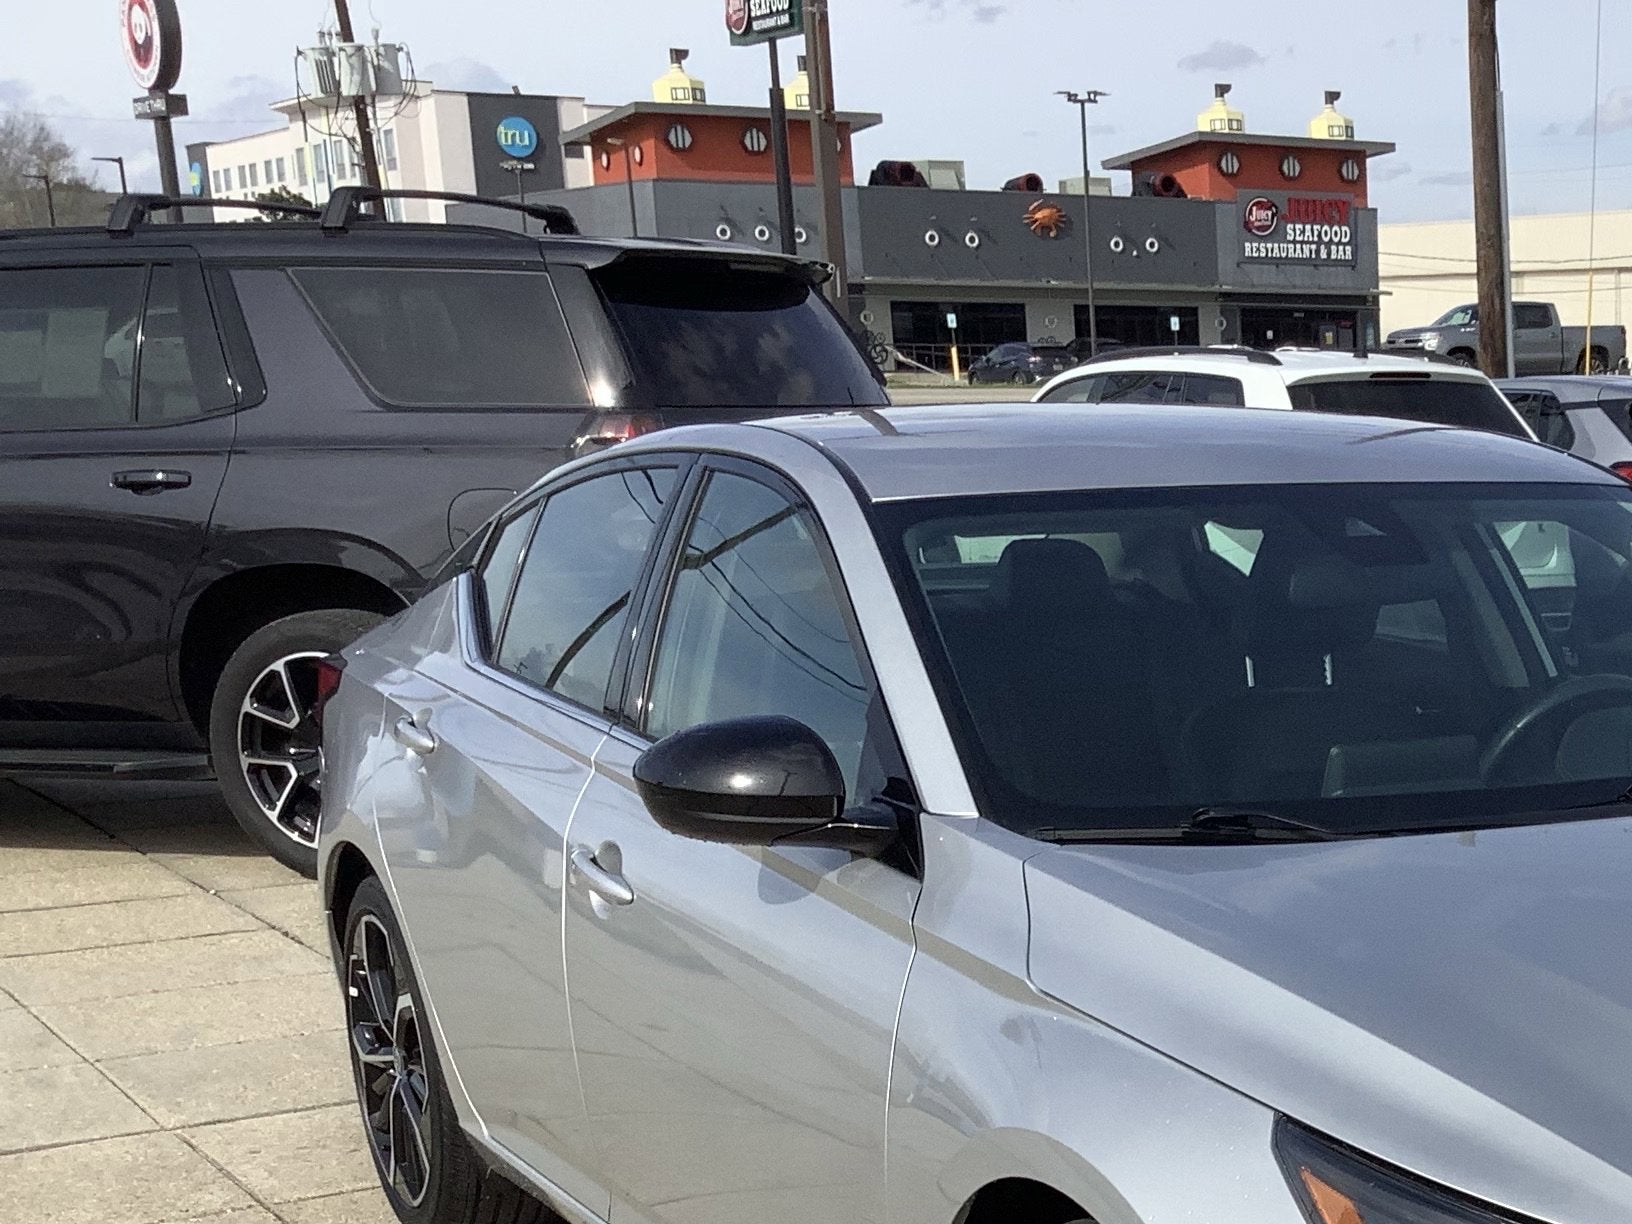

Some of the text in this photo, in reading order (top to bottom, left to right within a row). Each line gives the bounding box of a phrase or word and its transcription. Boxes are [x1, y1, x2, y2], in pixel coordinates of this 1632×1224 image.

[498, 124, 529, 146] tru
[1281, 198, 1351, 224] JUICY
[1286, 224, 1351, 243] SEAFOOD
[1244, 242, 1353, 260] RESTAURANT & BAR
